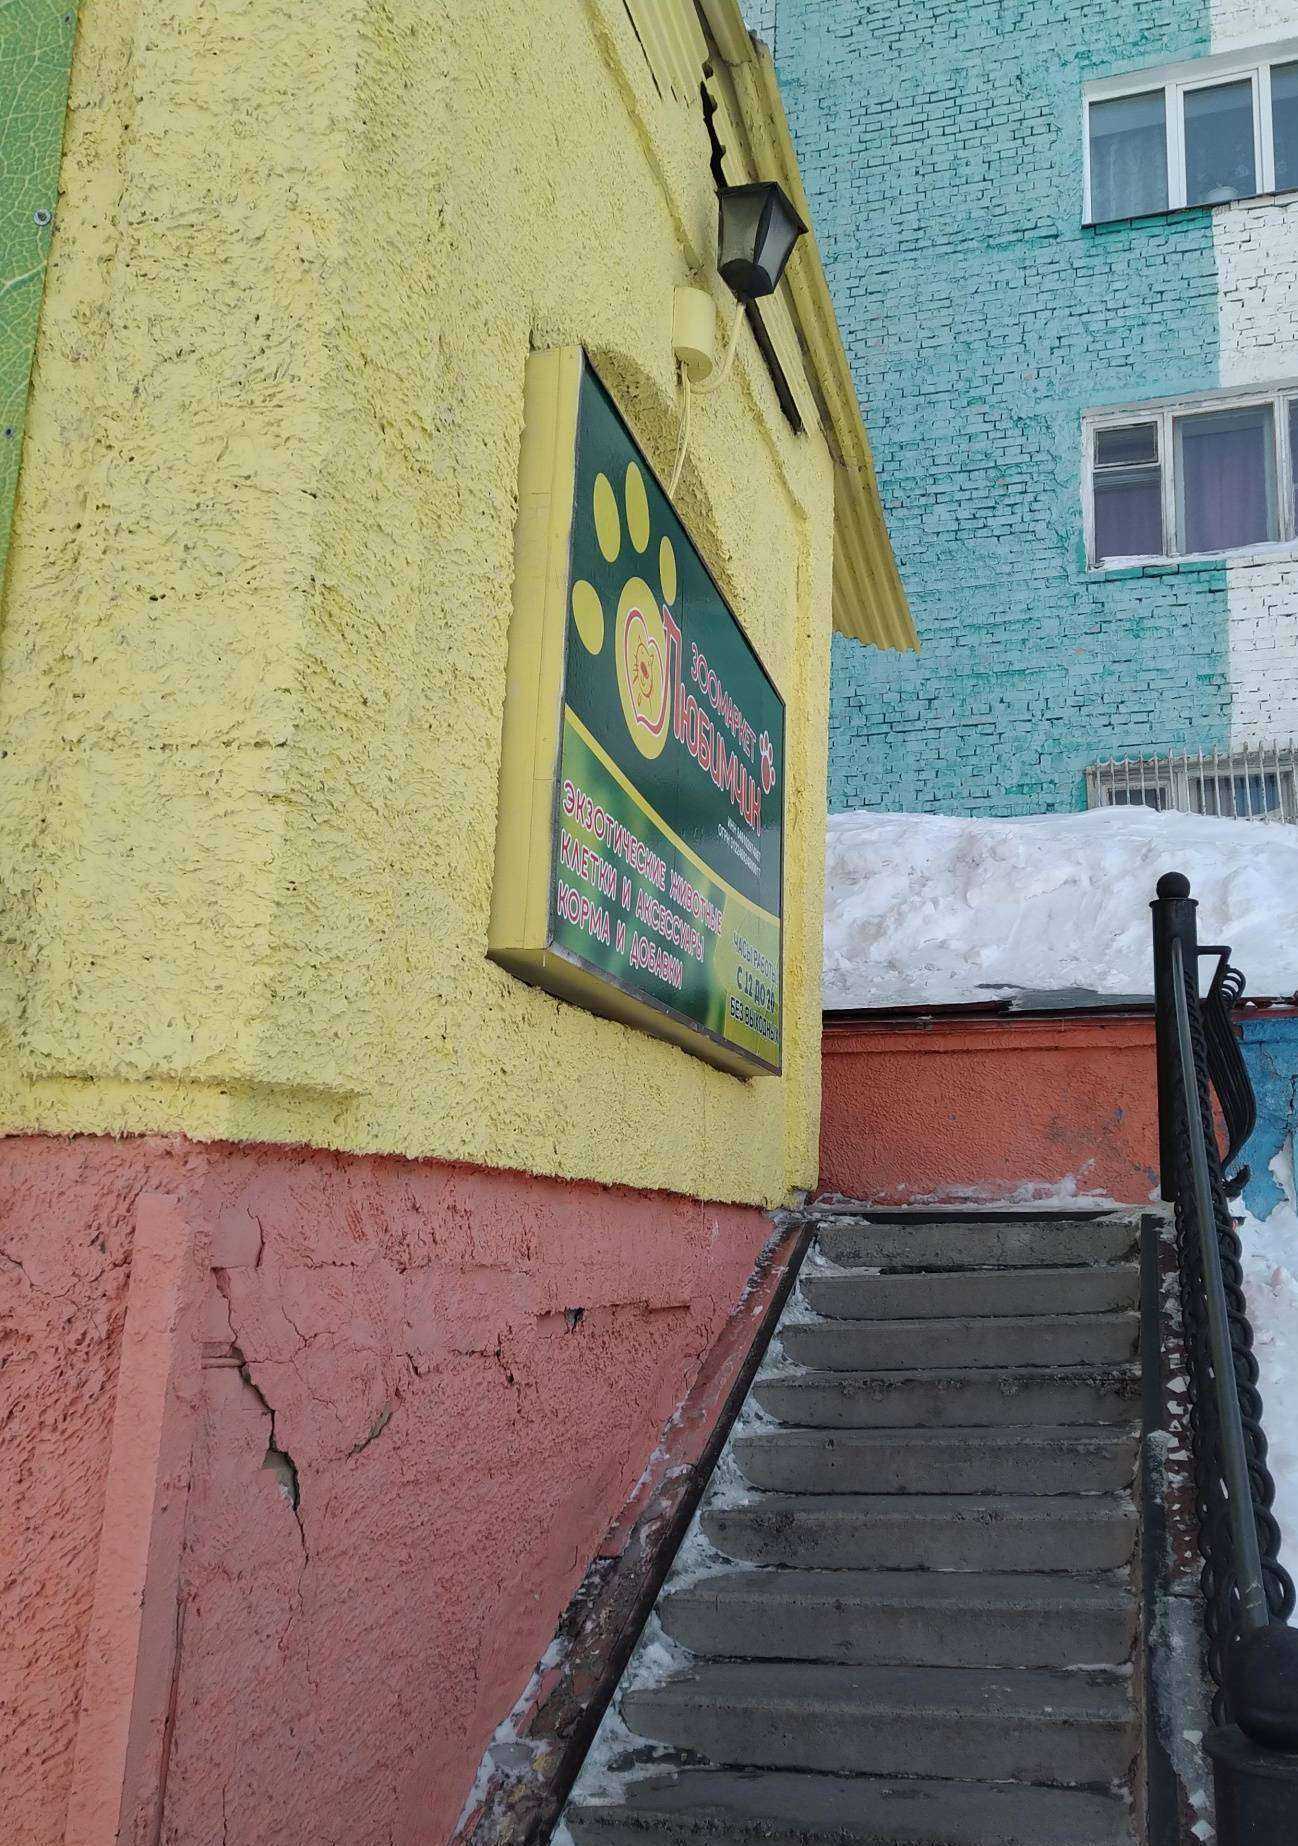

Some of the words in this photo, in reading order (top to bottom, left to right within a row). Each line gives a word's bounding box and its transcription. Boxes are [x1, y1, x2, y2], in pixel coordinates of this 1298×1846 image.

[690, 641, 757, 763] ЗООМАРКЕТ
[560, 828, 618, 901] КЛЕТКИ
[621, 875, 632, 911] И
[635, 887, 705, 963] АКСЕССУАРЫ
[563, 780, 666, 891] ЭКЗОТИЧЕСКИЕ
[669, 868, 725, 937] ЖИВОТНЫЕ
[557, 879, 610, 947] КОРМА
[615, 919, 626, 955] И
[629, 930, 684, 990] ДОБАВКИ
[733, 929, 753, 961] ЧАСЫ
[736, 965, 743, 990] С
[744, 972, 753, 998] 12
[754, 978, 766, 1009] ДО
[766, 987, 775, 1015] 20
[730, 996, 744, 1022] БЕЗ
